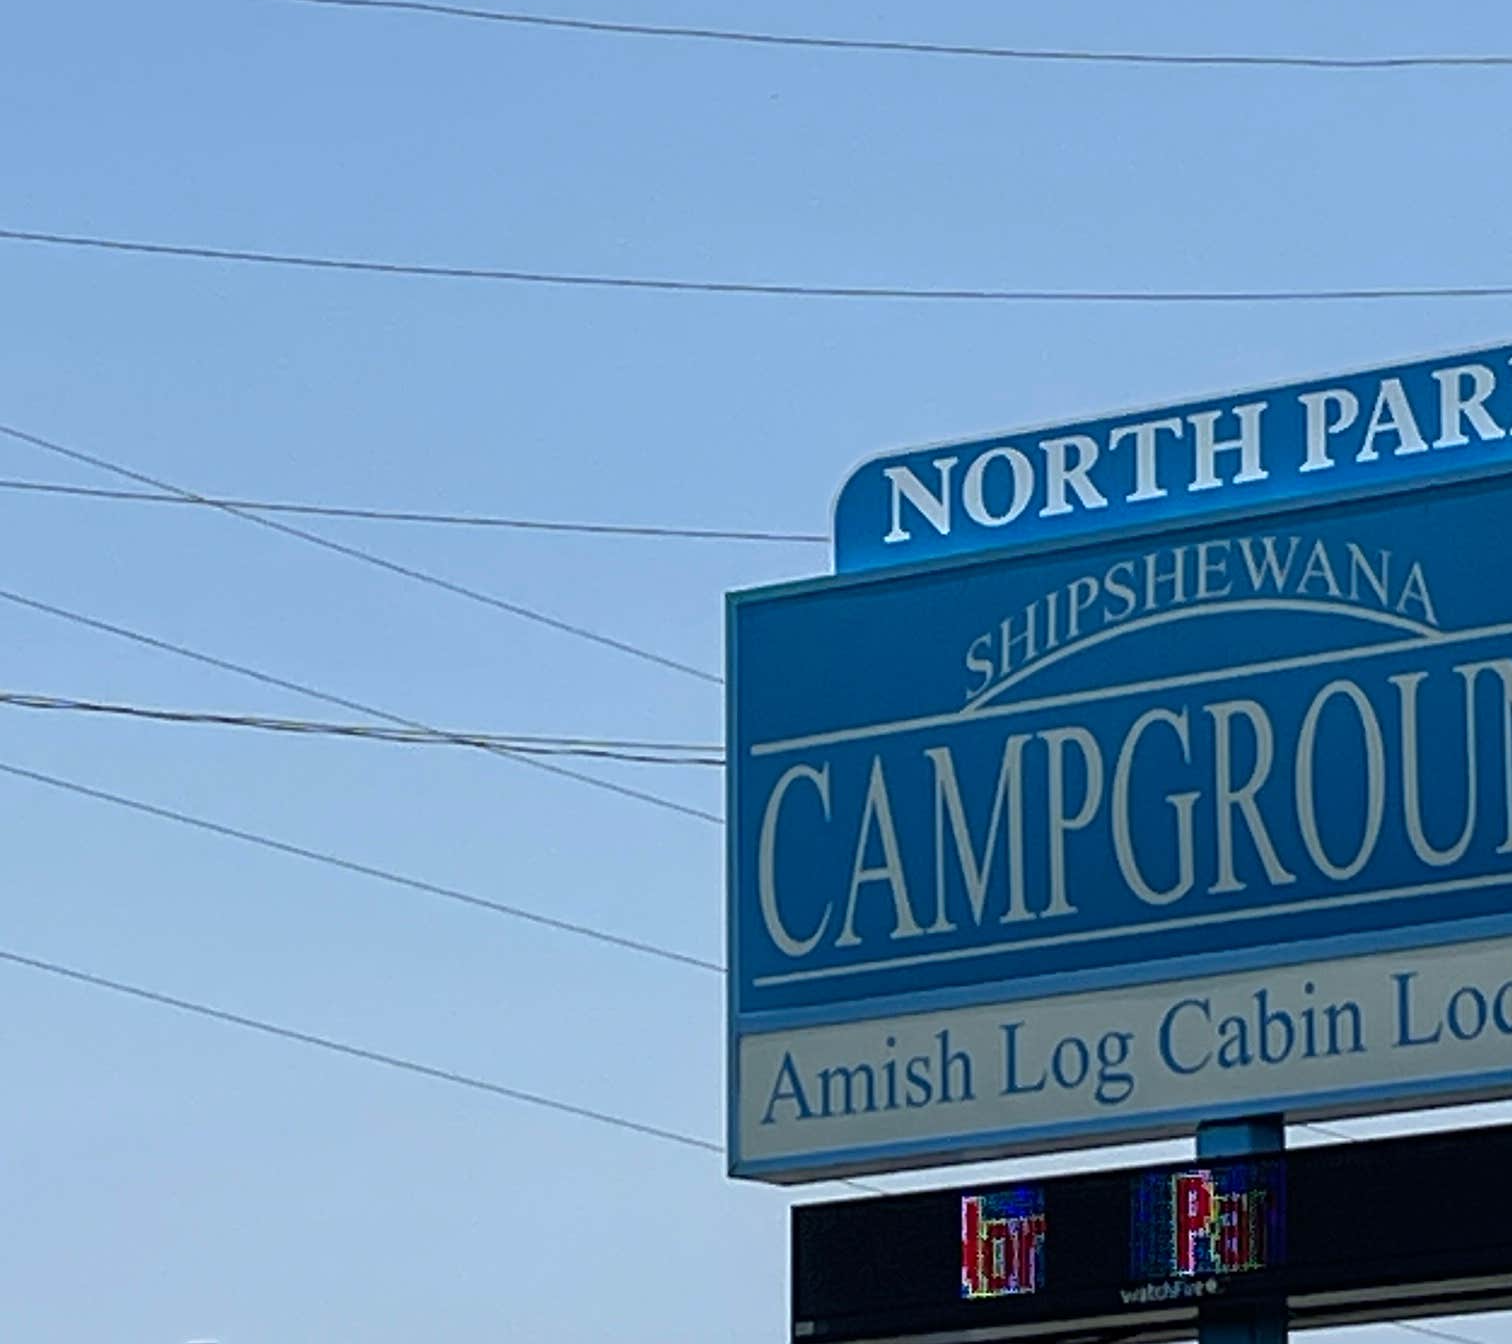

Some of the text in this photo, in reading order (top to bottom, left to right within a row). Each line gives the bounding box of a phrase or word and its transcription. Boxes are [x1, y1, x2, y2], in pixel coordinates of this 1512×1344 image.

[883, 400, 1271, 544] NORTH
[964, 535, 1439, 701] SHIPSHEWANA
[759, 1028, 977, 1126] Amish
[999, 1020, 1136, 1105] Log
[1157, 980, 1368, 1076] Cabin
